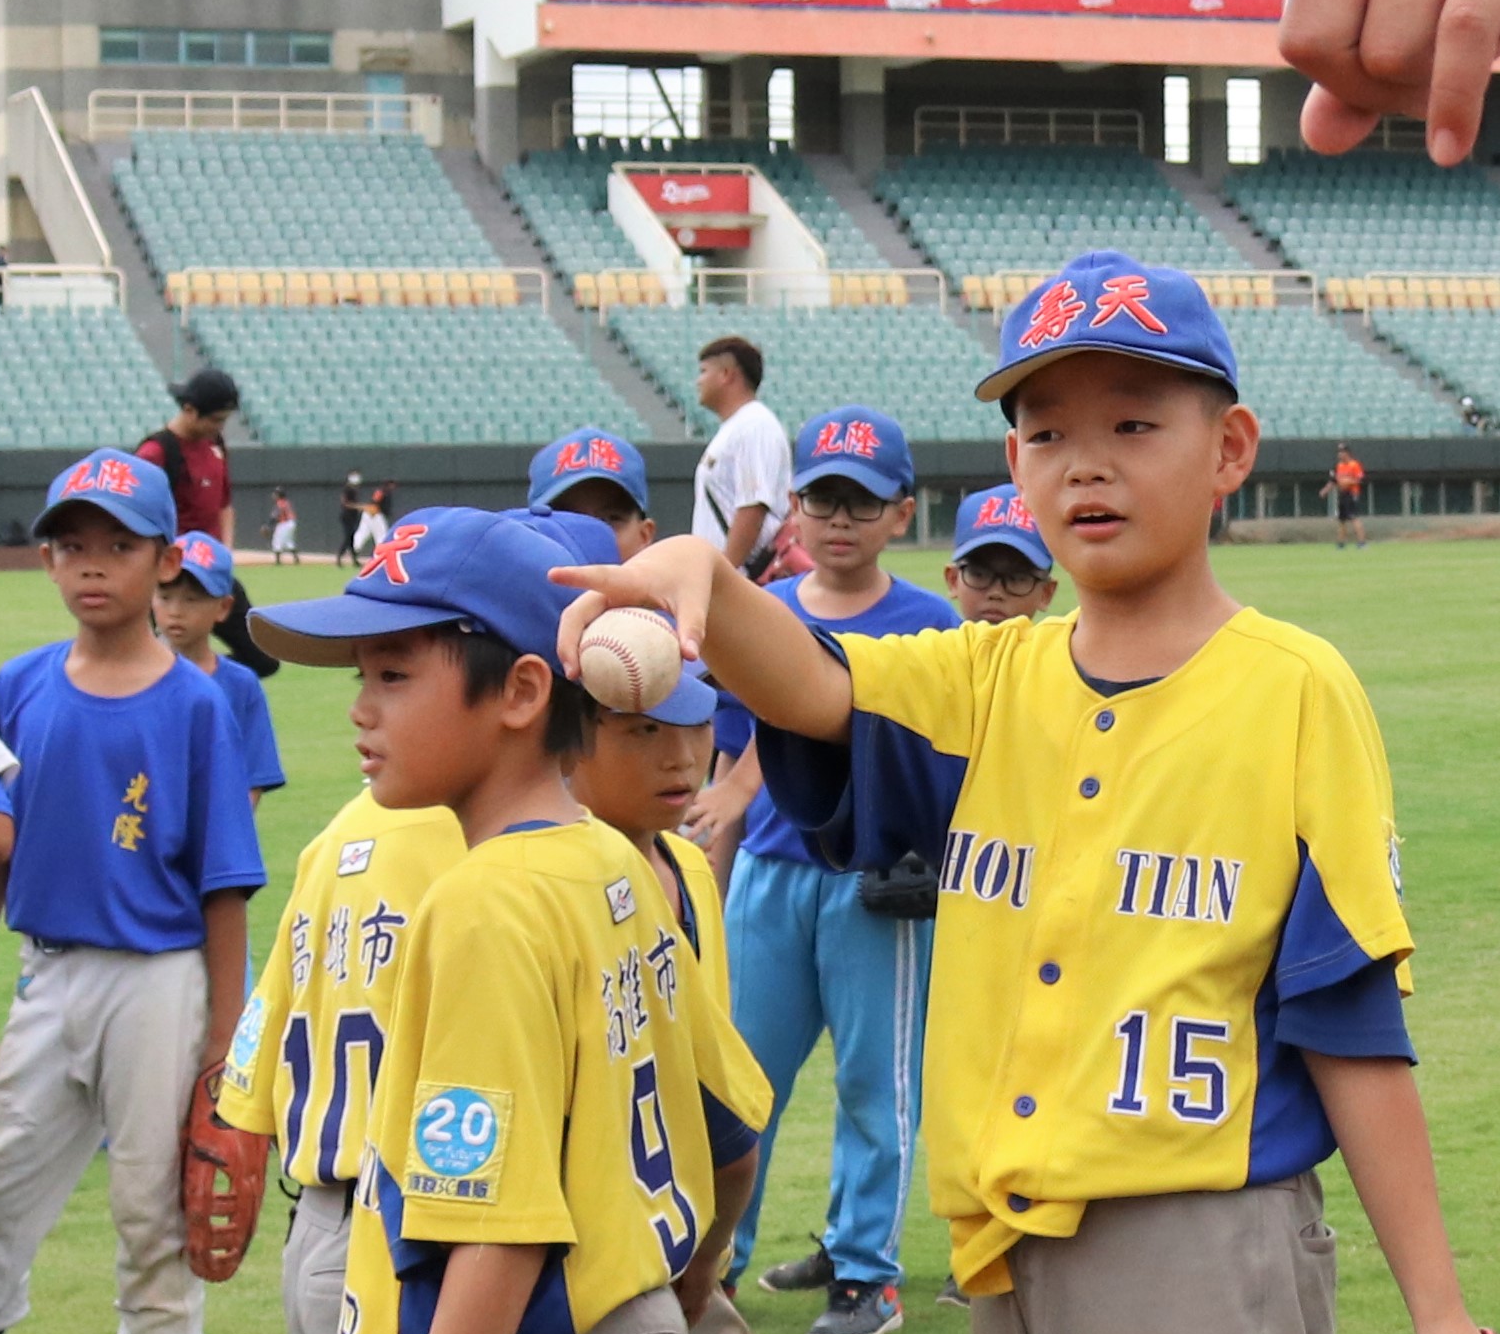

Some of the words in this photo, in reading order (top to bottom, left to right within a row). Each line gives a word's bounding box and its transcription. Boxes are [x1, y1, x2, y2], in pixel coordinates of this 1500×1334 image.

[1018, 275, 1169, 351] 壽天
[1116, 847, 1243, 925] TIAN
[291, 899, 408, 988] 高雄市
[280, 1007, 387, 1186] 10
[1106, 1009, 1232, 1126] 15
[423, 1098, 494, 1146] 20
[629, 1054, 699, 1283] 9
